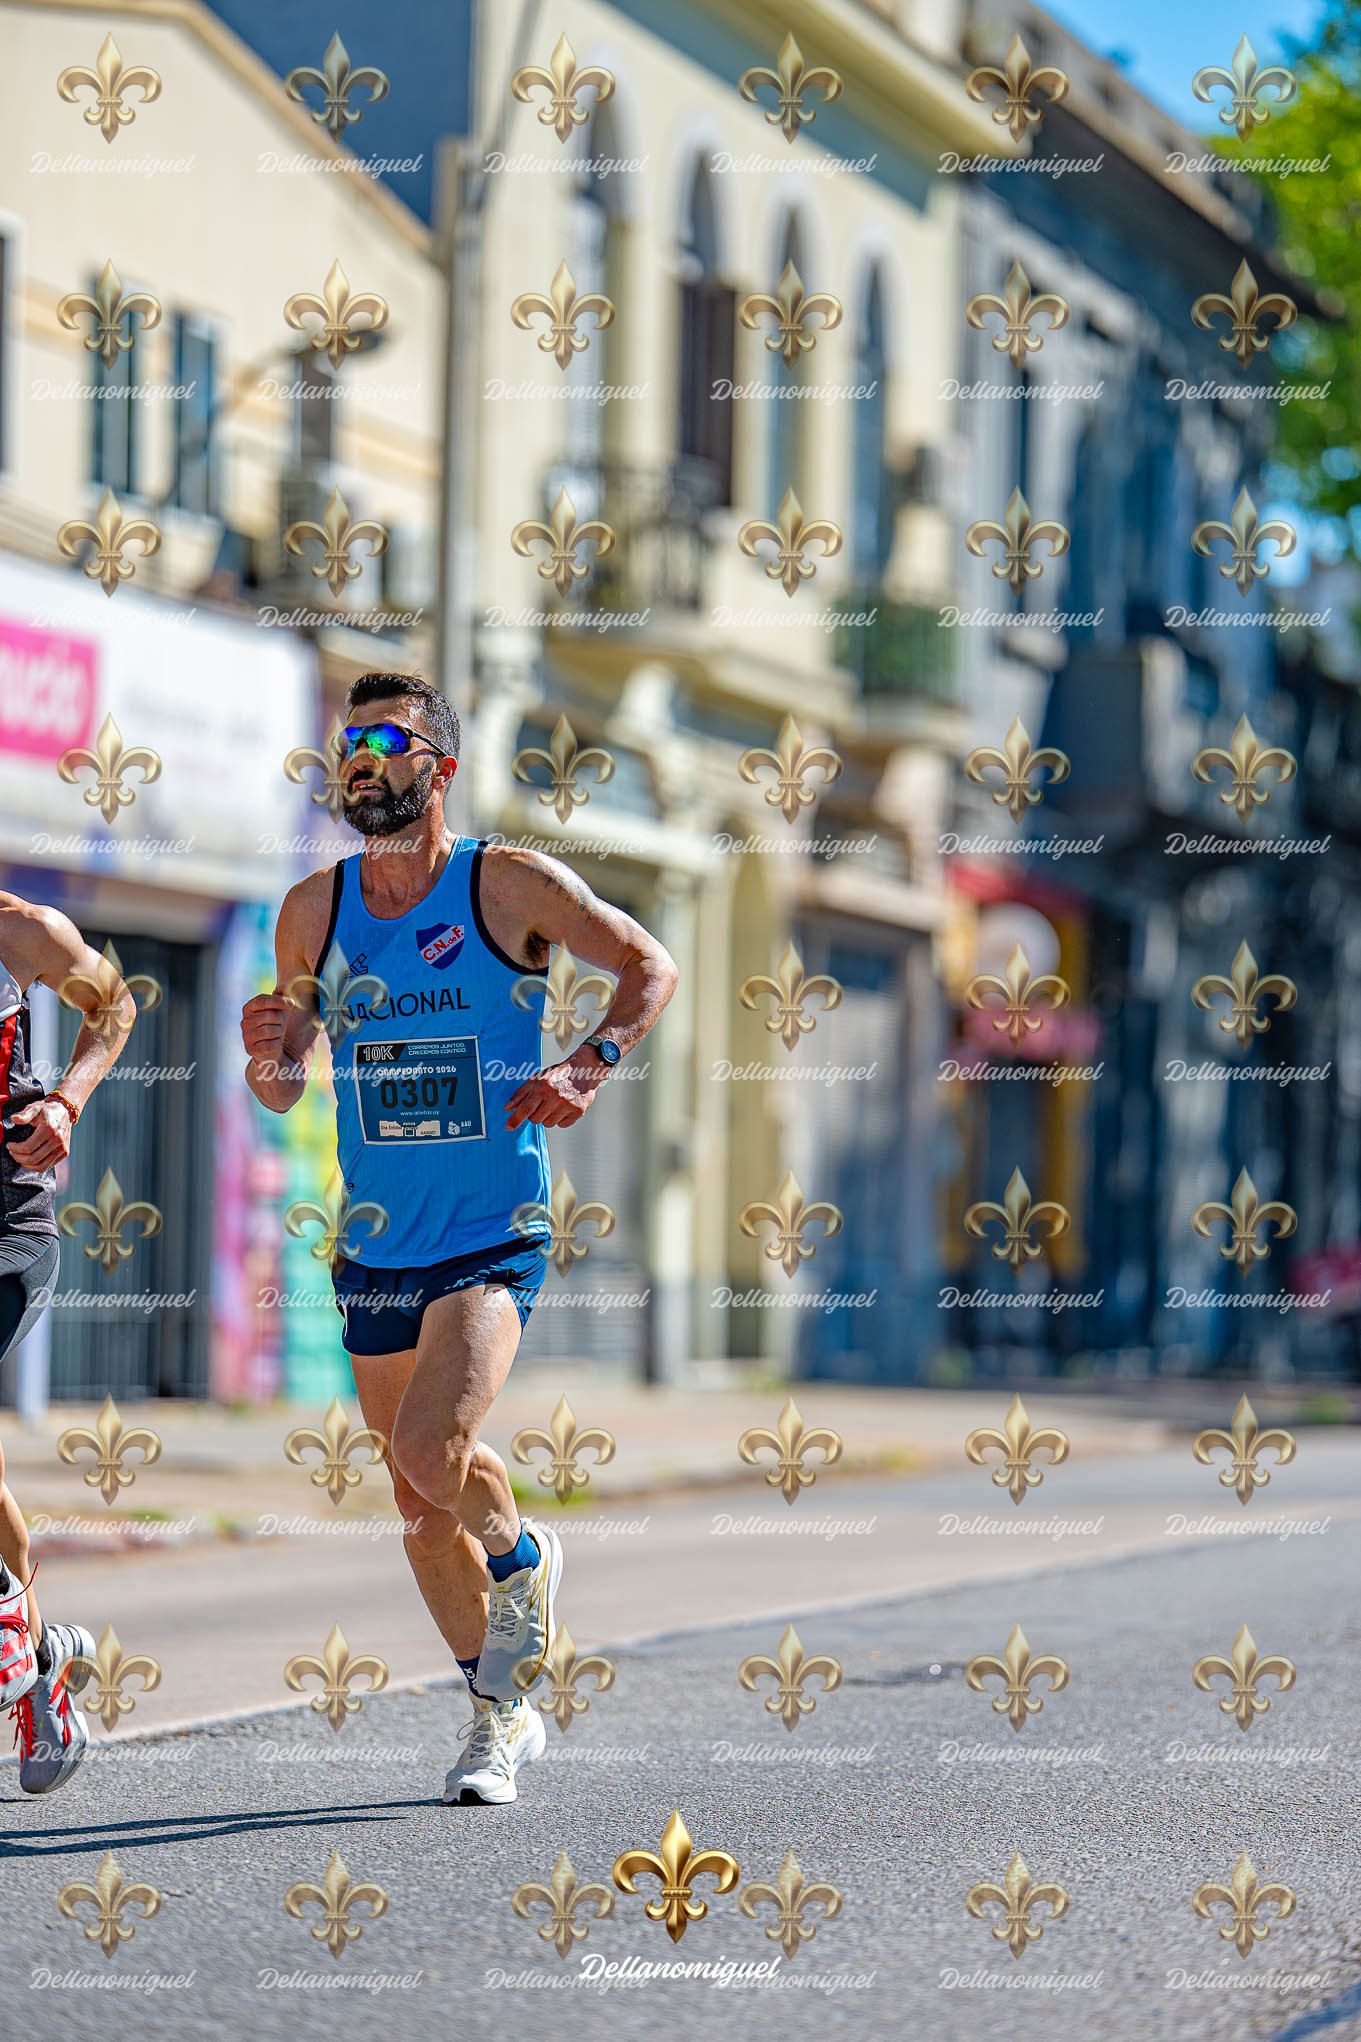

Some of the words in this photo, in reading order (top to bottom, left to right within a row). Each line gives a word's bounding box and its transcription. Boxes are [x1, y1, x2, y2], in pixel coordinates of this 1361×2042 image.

[363, 1045, 395, 1061] 10K
[435, 1065, 457, 1073] 2026
[380, 1076, 459, 1109] 0307
